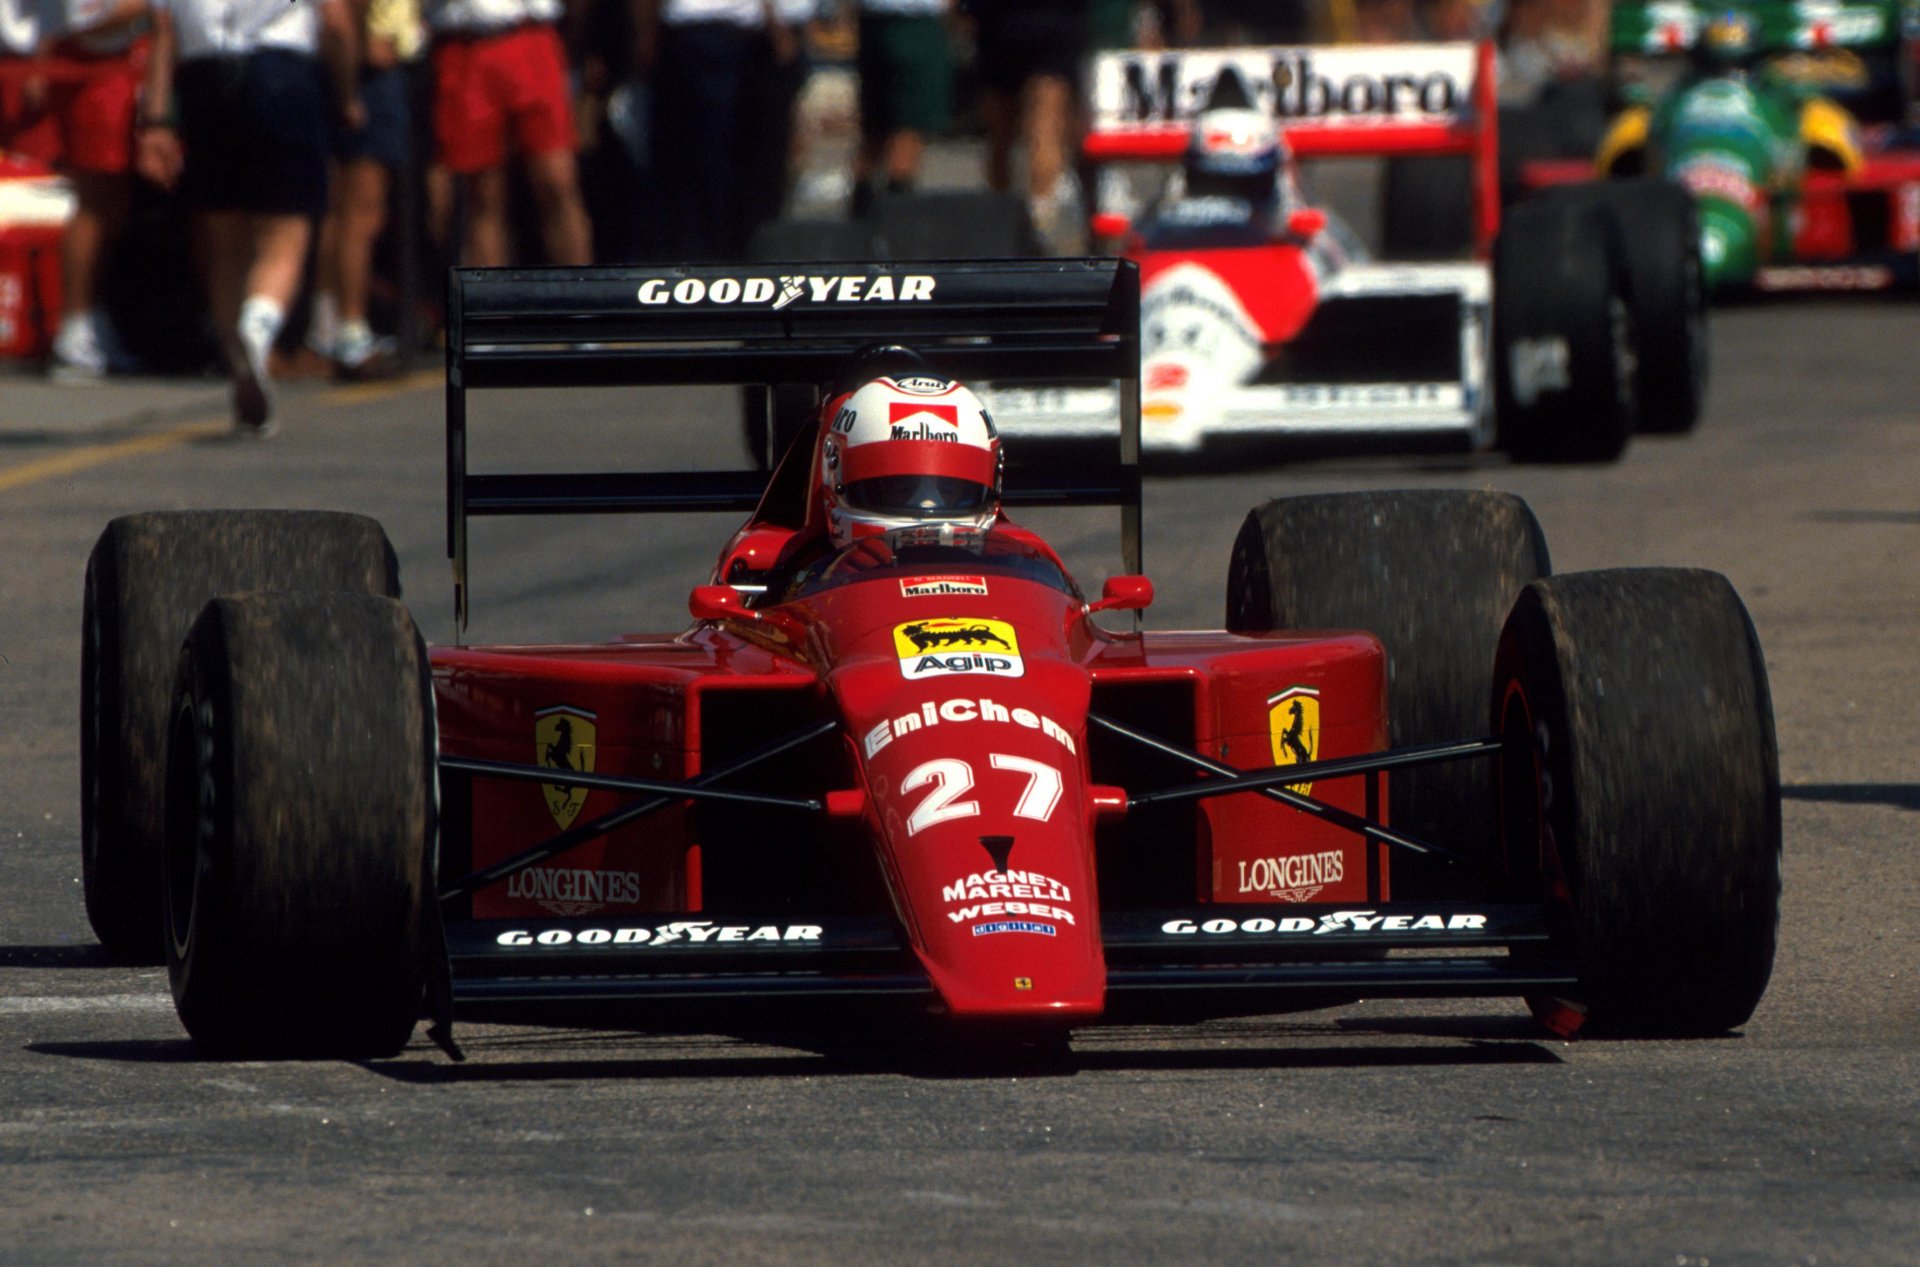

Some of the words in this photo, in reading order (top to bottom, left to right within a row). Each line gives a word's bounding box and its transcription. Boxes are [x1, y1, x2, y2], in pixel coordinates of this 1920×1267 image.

[1121, 50, 1456, 120] Mlboro
[890, 422, 959, 443] Marlboro
[905, 583, 986, 596] Marlboro
[913, 653, 1012, 673] Agip
[864, 698, 1077, 760] EniChem
[901, 752, 1064, 837] 27
[507, 867, 640, 904] LONGINES
[1239, 850, 1344, 893] LONGINES
[947, 901, 1076, 926] WEBER
[974, 922, 1055, 936] digital
